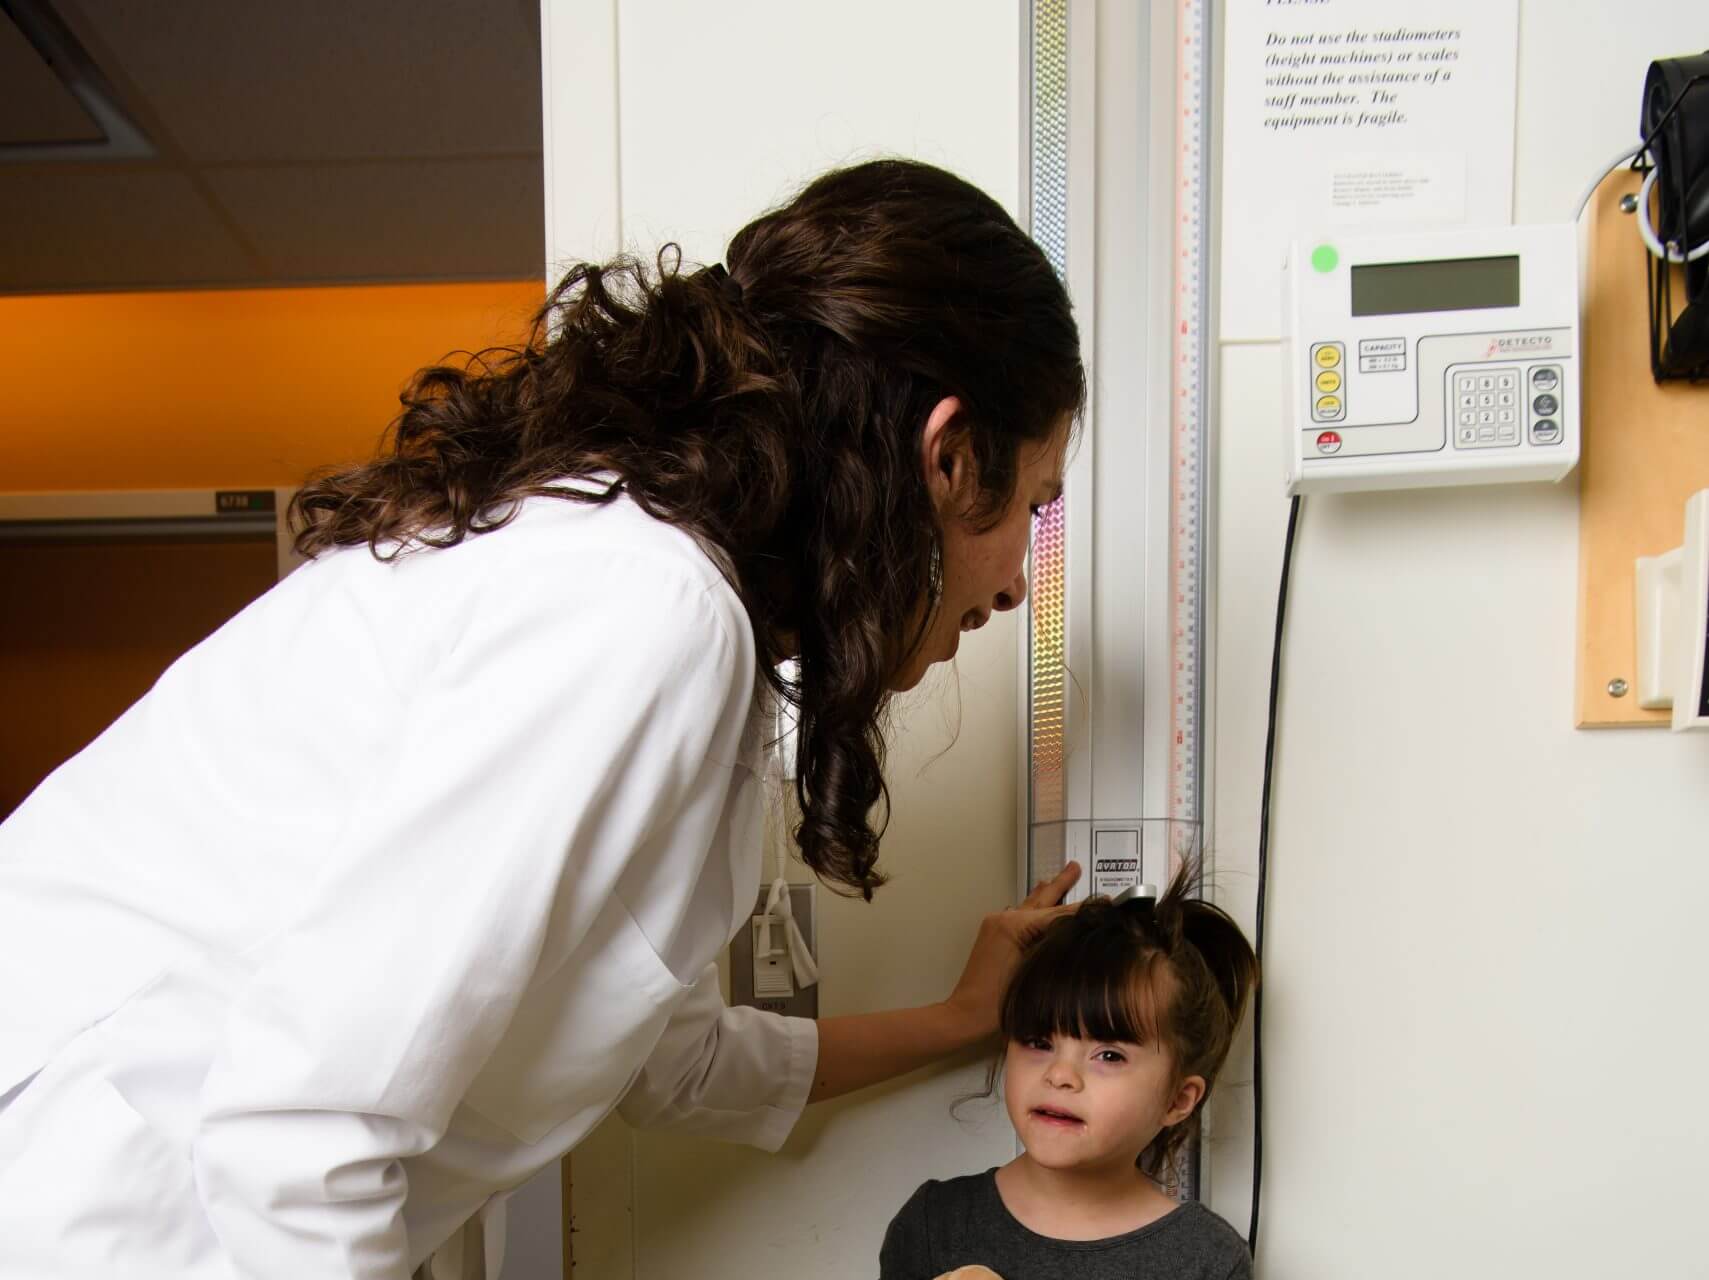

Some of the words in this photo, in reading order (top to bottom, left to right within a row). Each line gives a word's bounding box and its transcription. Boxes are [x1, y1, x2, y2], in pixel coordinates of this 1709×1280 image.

[1266, 32, 1287, 46] Do
[1290, 33, 1314, 46] not
[1319, 34, 1342, 45] use
[1346, 30, 1368, 44] the
[1373, 27, 1461, 43] stadiometers
[1265, 52, 1316, 69] (height
[1320, 50, 1393, 65] machines)
[1397, 53, 1412, 62] or
[1417, 48, 1459, 62] scales
[1265, 74, 1318, 87] without
[1322, 72, 1344, 86] the
[1348, 71, 1421, 85] assistance
[1424, 68, 1441, 86] of
[1443, 71, 1452, 81] a
[1265, 93, 1298, 110] staff
[1300, 91, 1360, 106] member.
[1372, 90, 1397, 104] The
[1264, 114, 1338, 131] equipment
[1342, 112, 1353, 126] is
[1357, 109, 1407, 128] fragile.
[1364, 343, 1402, 352] CAPACITY
[1498, 336, 1552, 347] DETECTO
